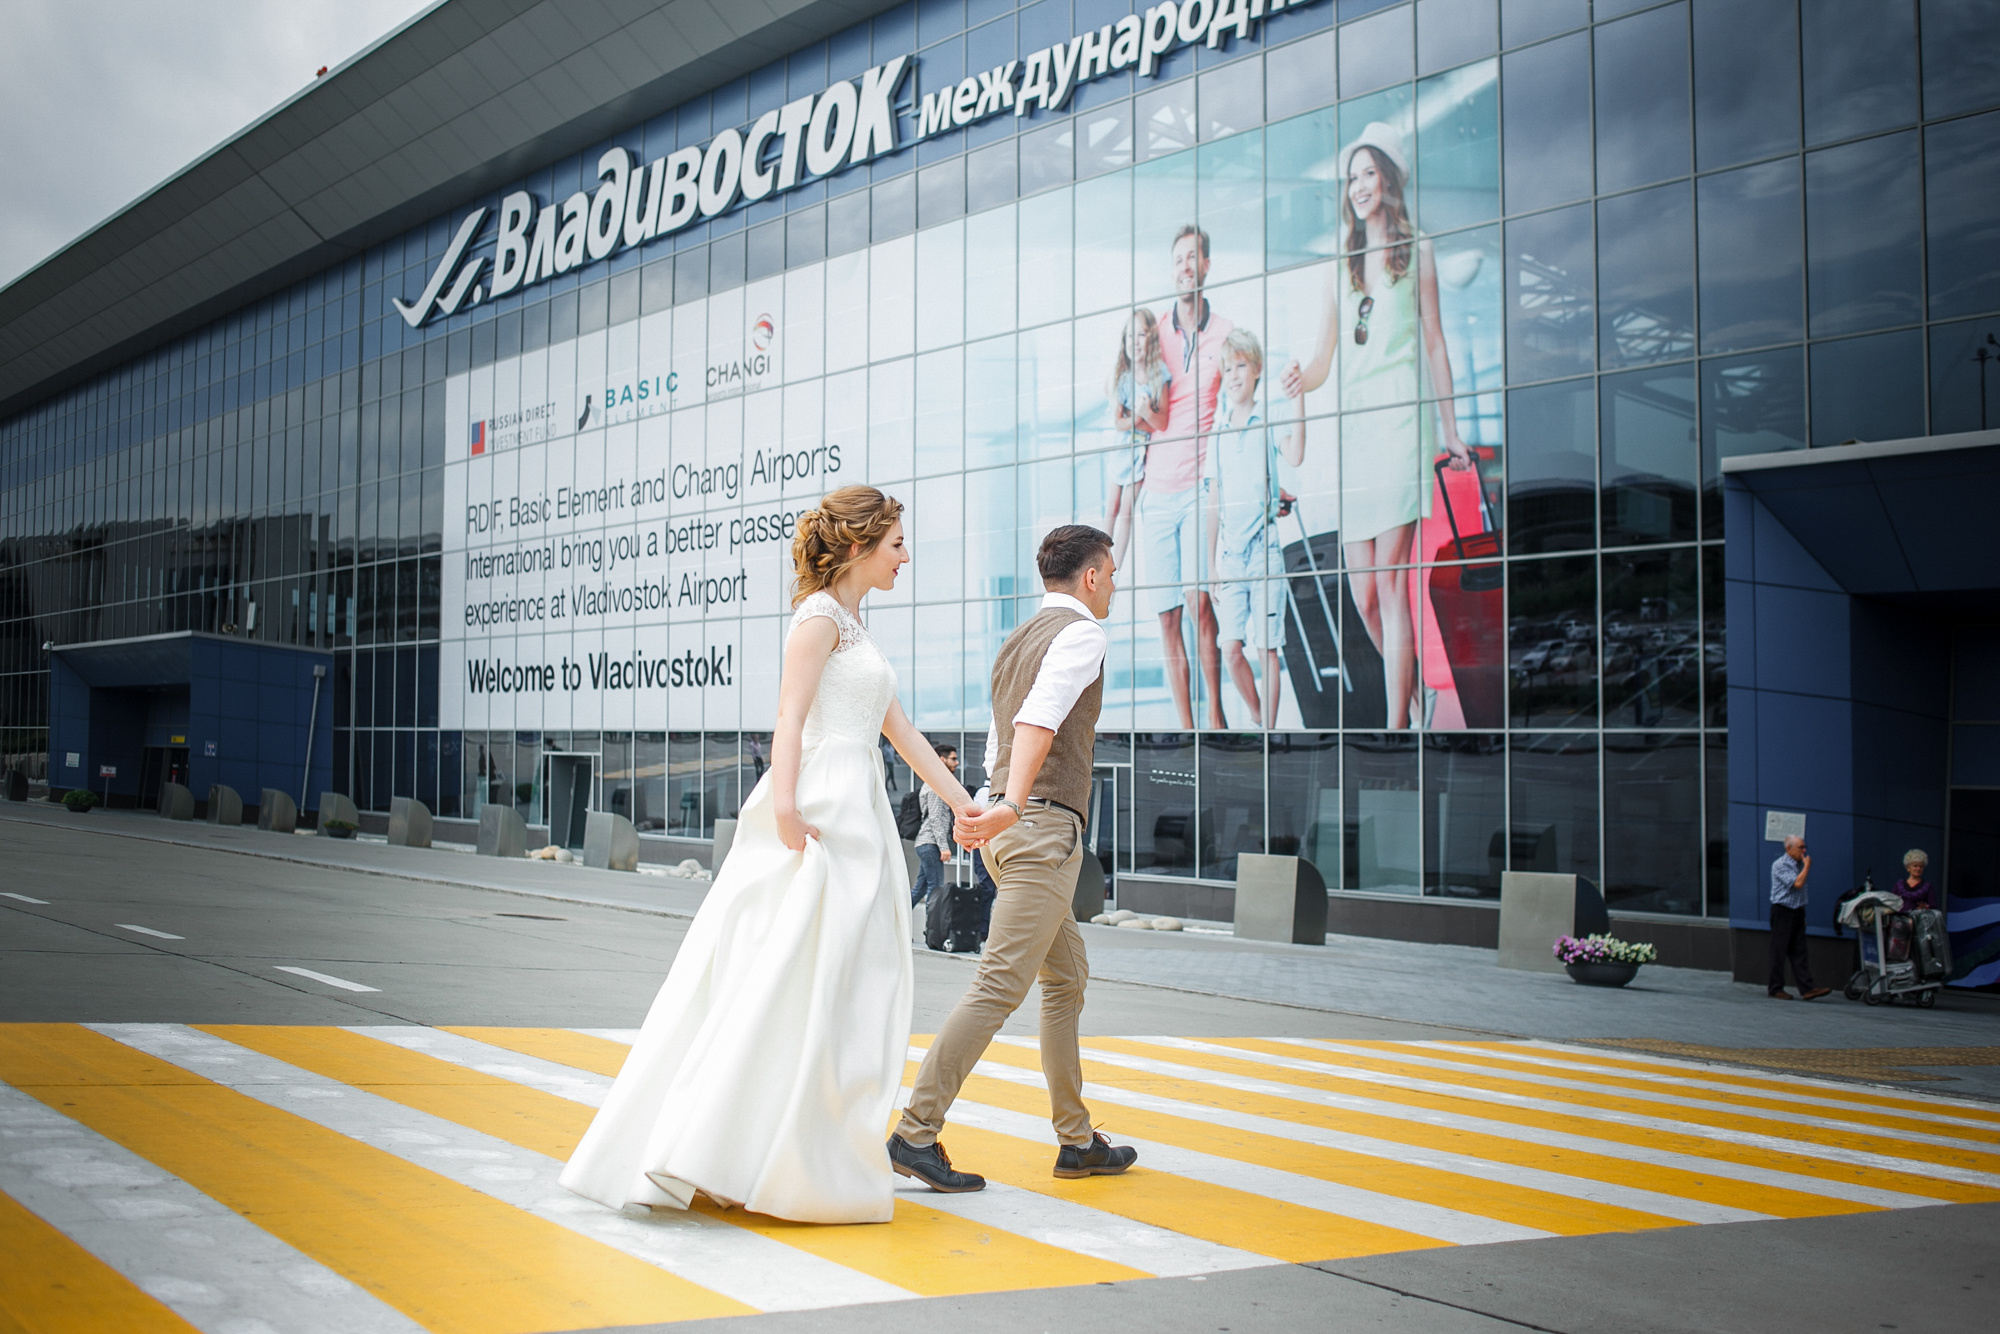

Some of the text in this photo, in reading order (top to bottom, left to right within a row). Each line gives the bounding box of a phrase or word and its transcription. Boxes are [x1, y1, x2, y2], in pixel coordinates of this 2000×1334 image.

[489, 0, 1306, 299] Владивосток международ
[606, 372, 678, 409] BASIC
[706, 354, 770, 387] CHANGI
[488, 402, 556, 432] RUSSIAN DIRECT
[467, 500, 503, 535] RDIF,
[509, 492, 551, 527] Basic
[557, 478, 624, 519] Element
[631, 468, 665, 506] and
[672, 452, 743, 499] Changi
[466, 538, 555, 580] International
[561, 535, 602, 572] bring
[608, 534, 640, 570] you
[647, 531, 658, 556] a
[665, 518, 722, 555] better
[465, 568, 748, 632] experience at Vladivostok Airport
[468, 658, 555, 694] Welcome
[561, 656, 581, 691] to
